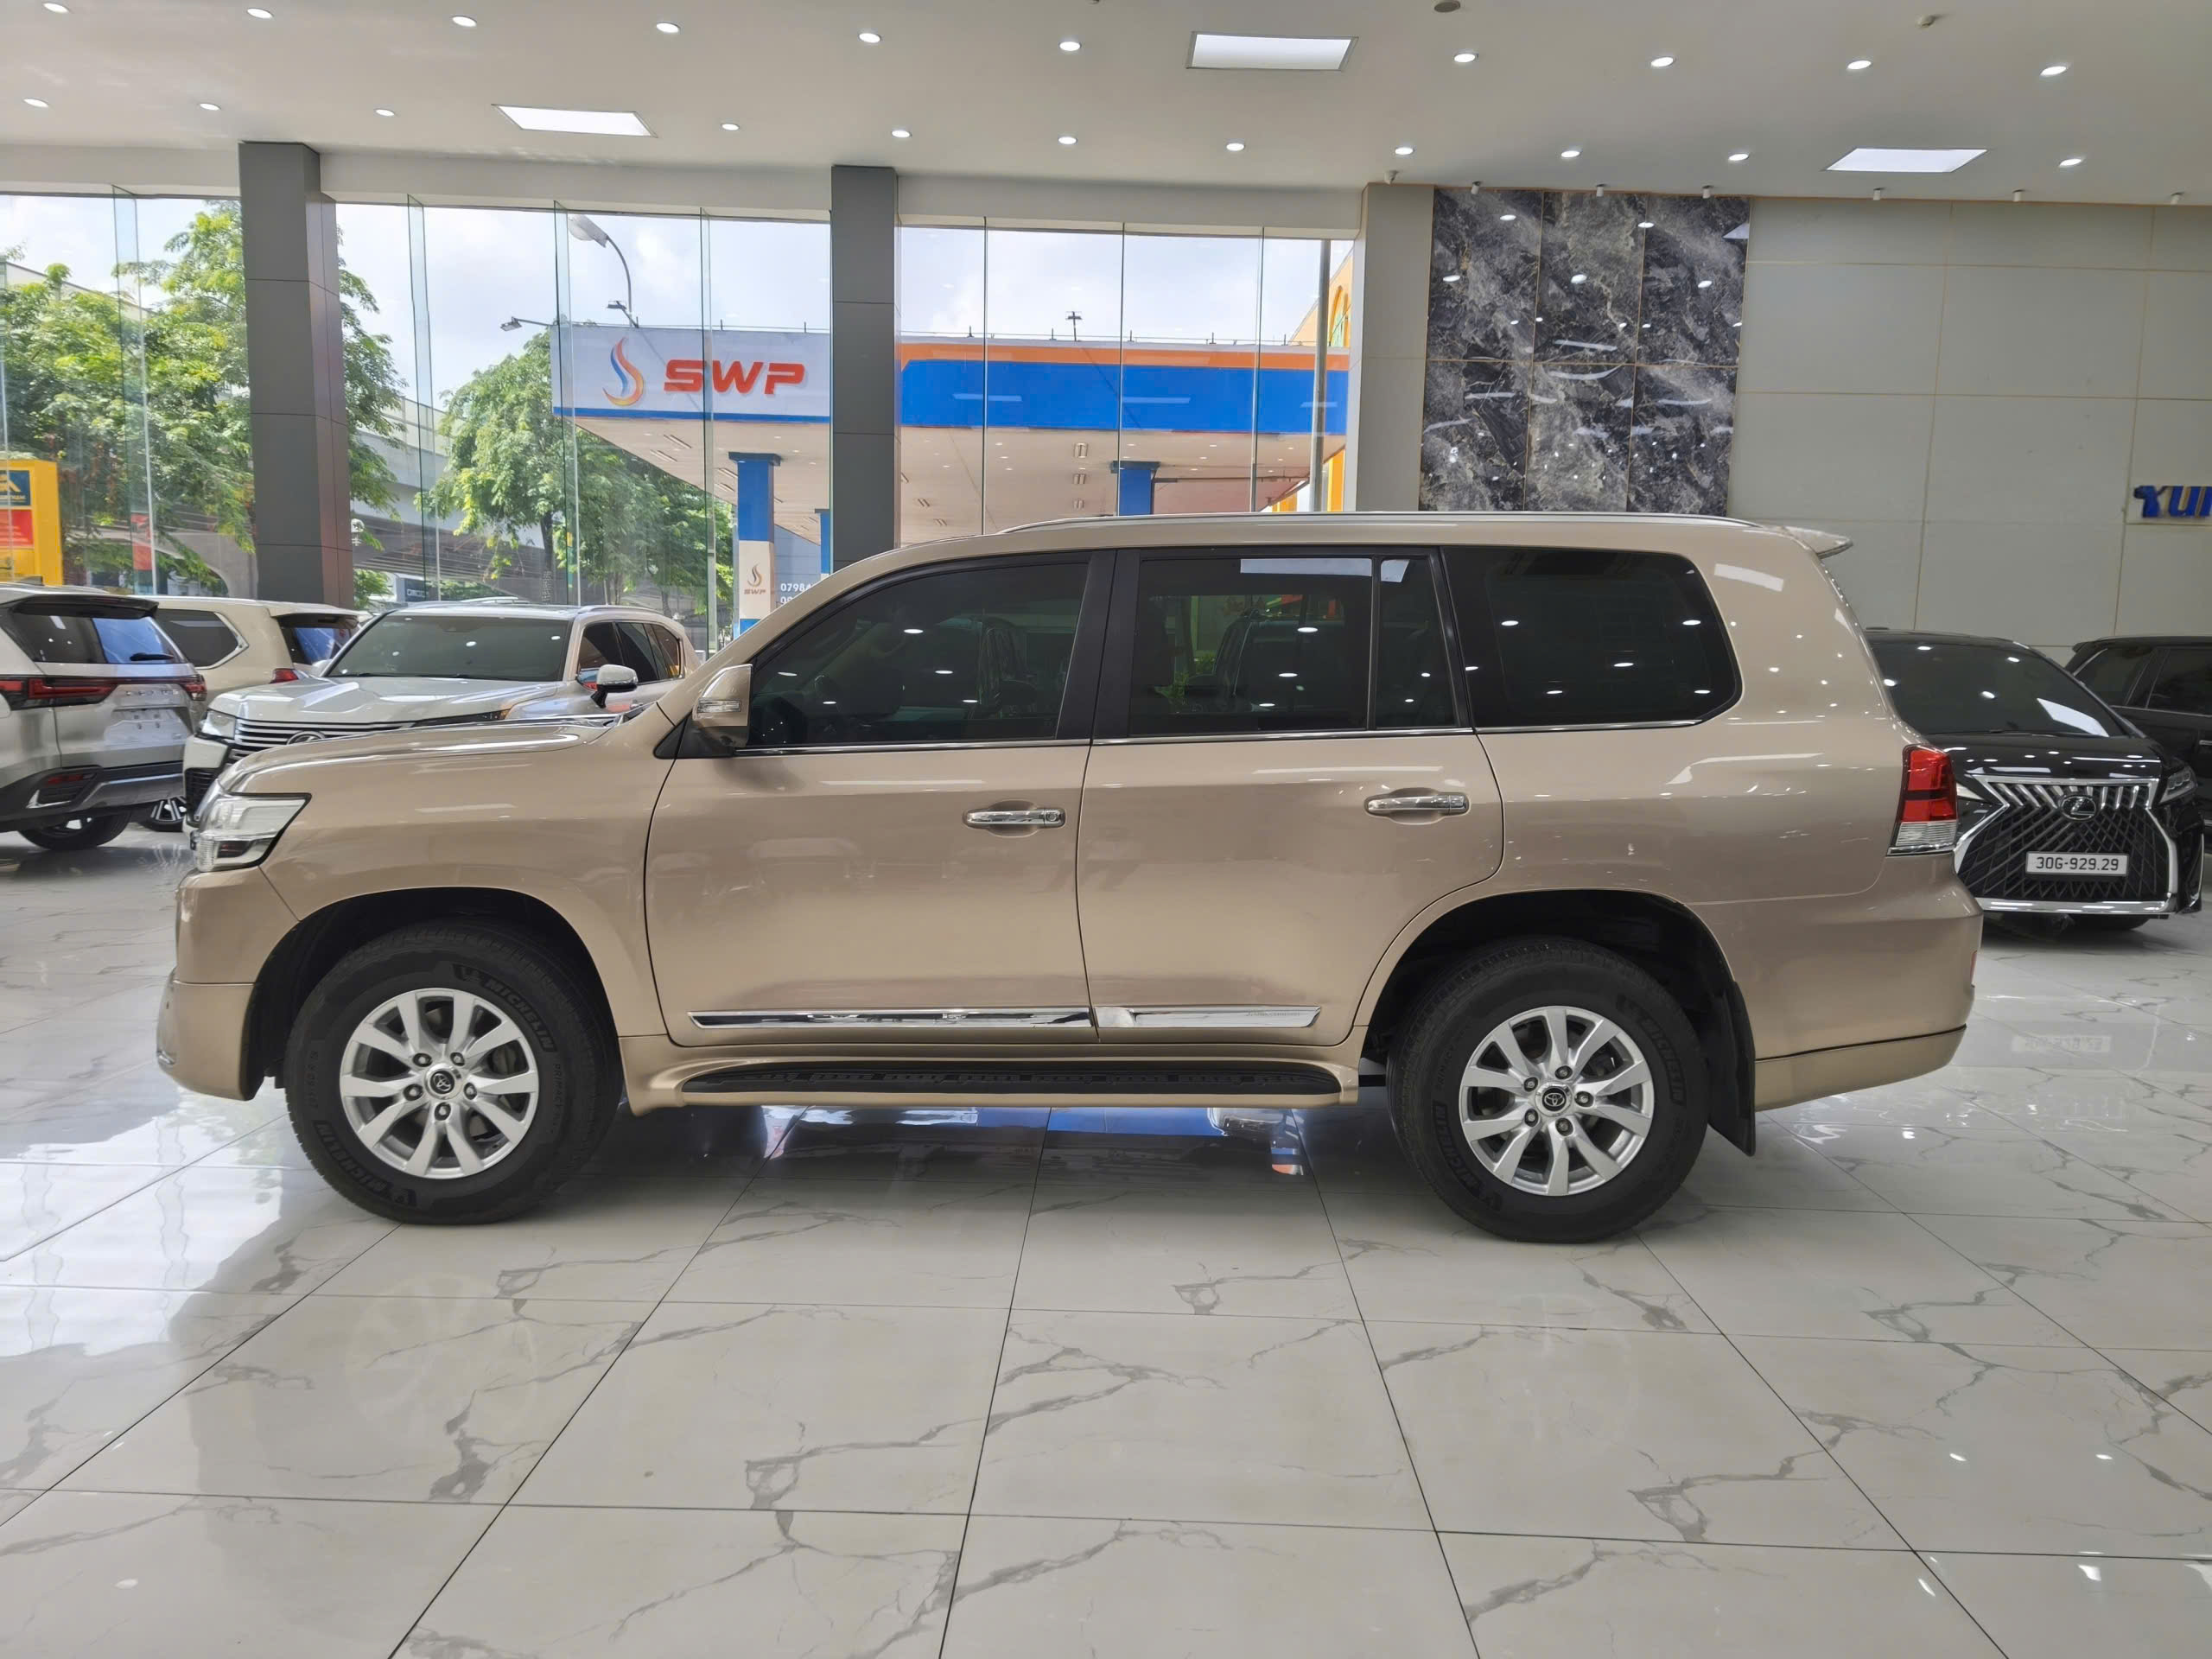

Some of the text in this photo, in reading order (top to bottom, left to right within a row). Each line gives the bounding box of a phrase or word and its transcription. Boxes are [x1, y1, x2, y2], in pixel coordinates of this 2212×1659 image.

[664, 359, 805, 394] SWP
[2036, 856, 2119, 871] 30G-929.29
[486, 978, 556, 1052] MICHELIN
[315, 1122, 390, 1195] MICHELIN
[1433, 1102, 1481, 1196] MICHELIN
